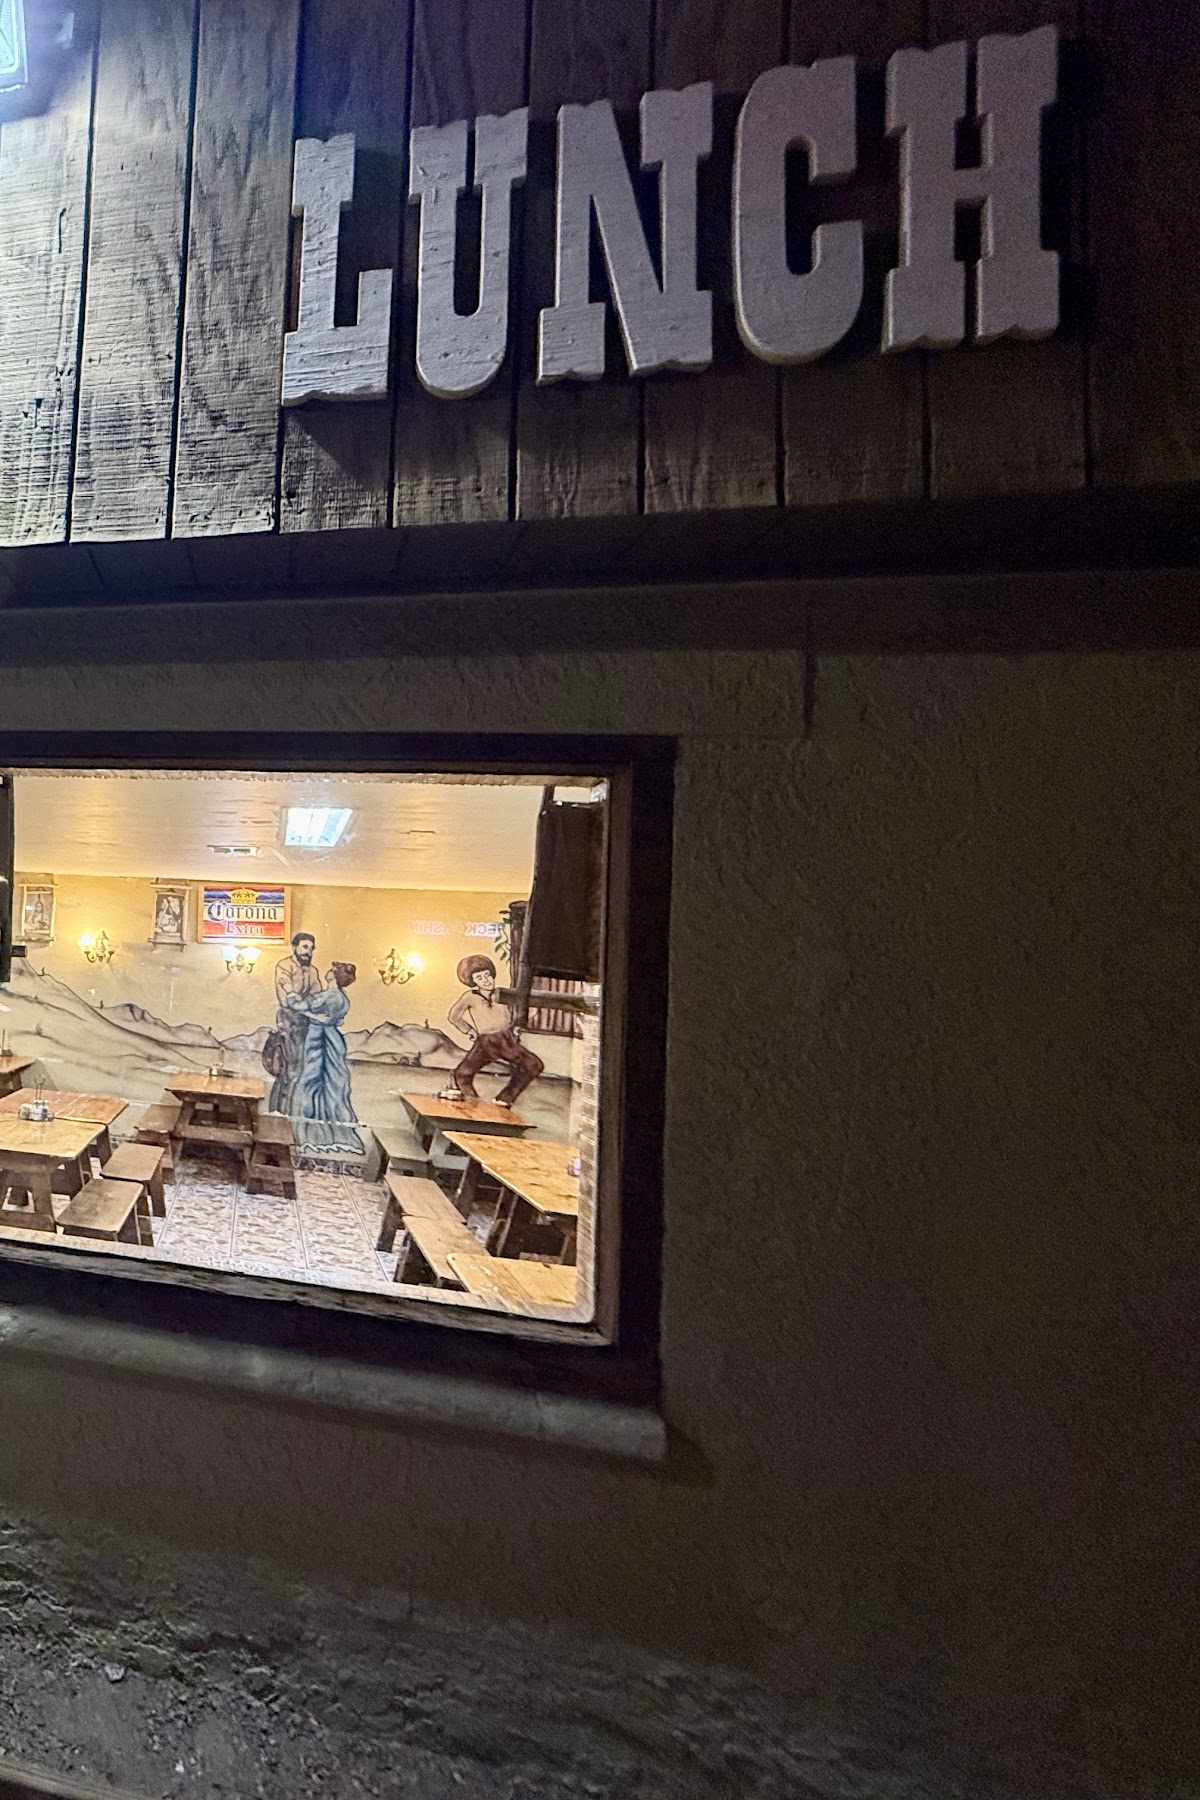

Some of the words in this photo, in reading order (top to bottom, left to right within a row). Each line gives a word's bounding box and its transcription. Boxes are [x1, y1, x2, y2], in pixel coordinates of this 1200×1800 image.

[281, 25, 1059, 406] LUNCH
[208, 901, 277, 920] Corona
[226, 921, 264, 934] Extra
